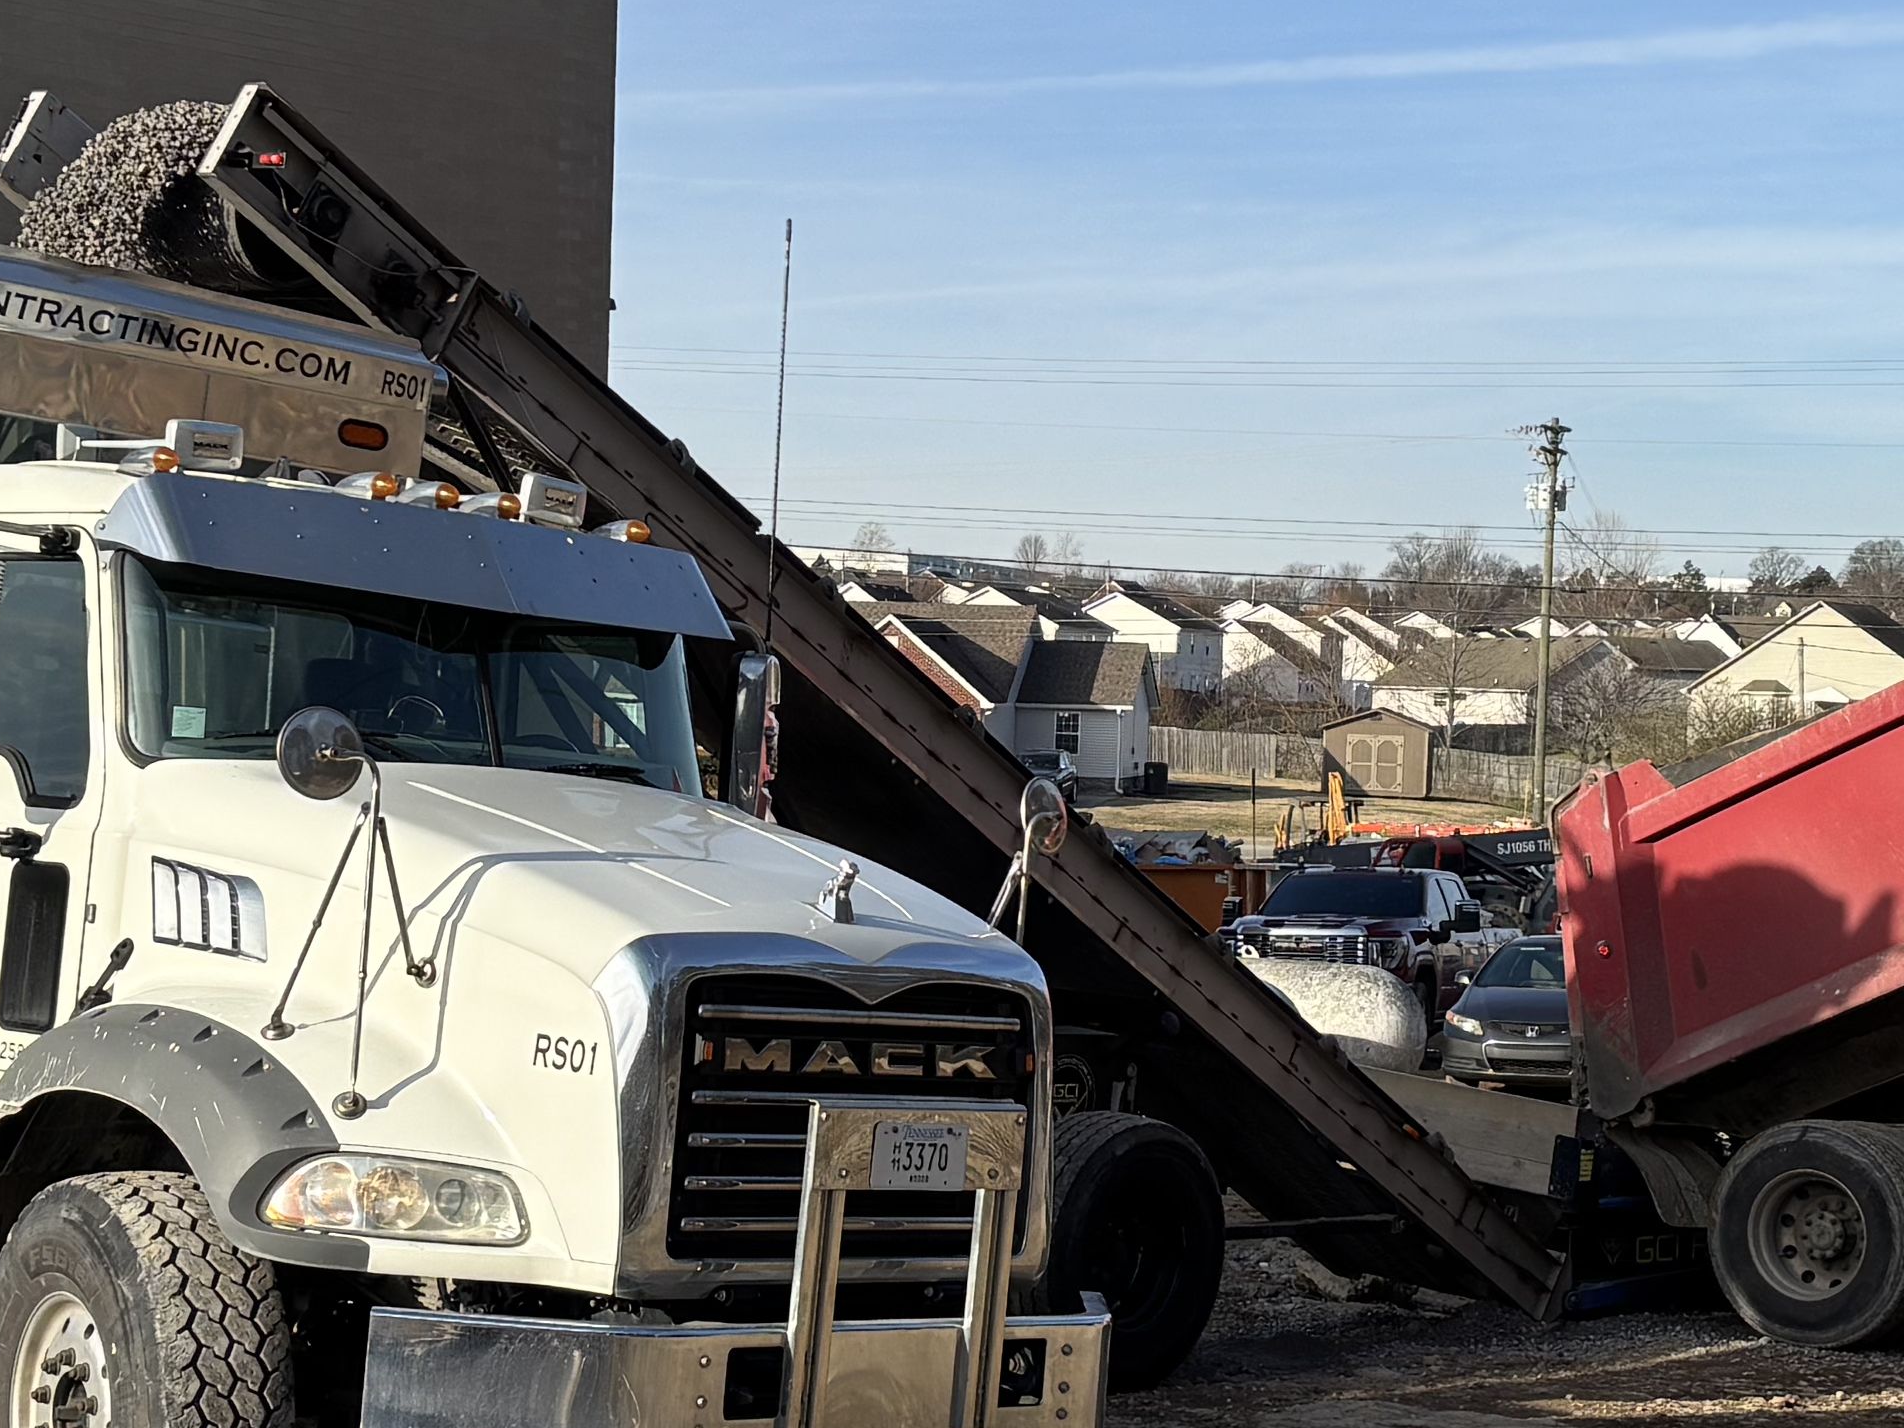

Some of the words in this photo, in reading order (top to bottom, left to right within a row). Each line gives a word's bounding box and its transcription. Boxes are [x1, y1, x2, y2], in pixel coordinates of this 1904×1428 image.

[381, 370, 426, 402] RS01
[1497, 840, 1536, 855] SJ1056
[1537, 839, 1552, 852] TH
[532, 1032, 598, 1075] RS01
[724, 1037, 997, 1079] MACK
[902, 1142, 948, 1171] 3370
